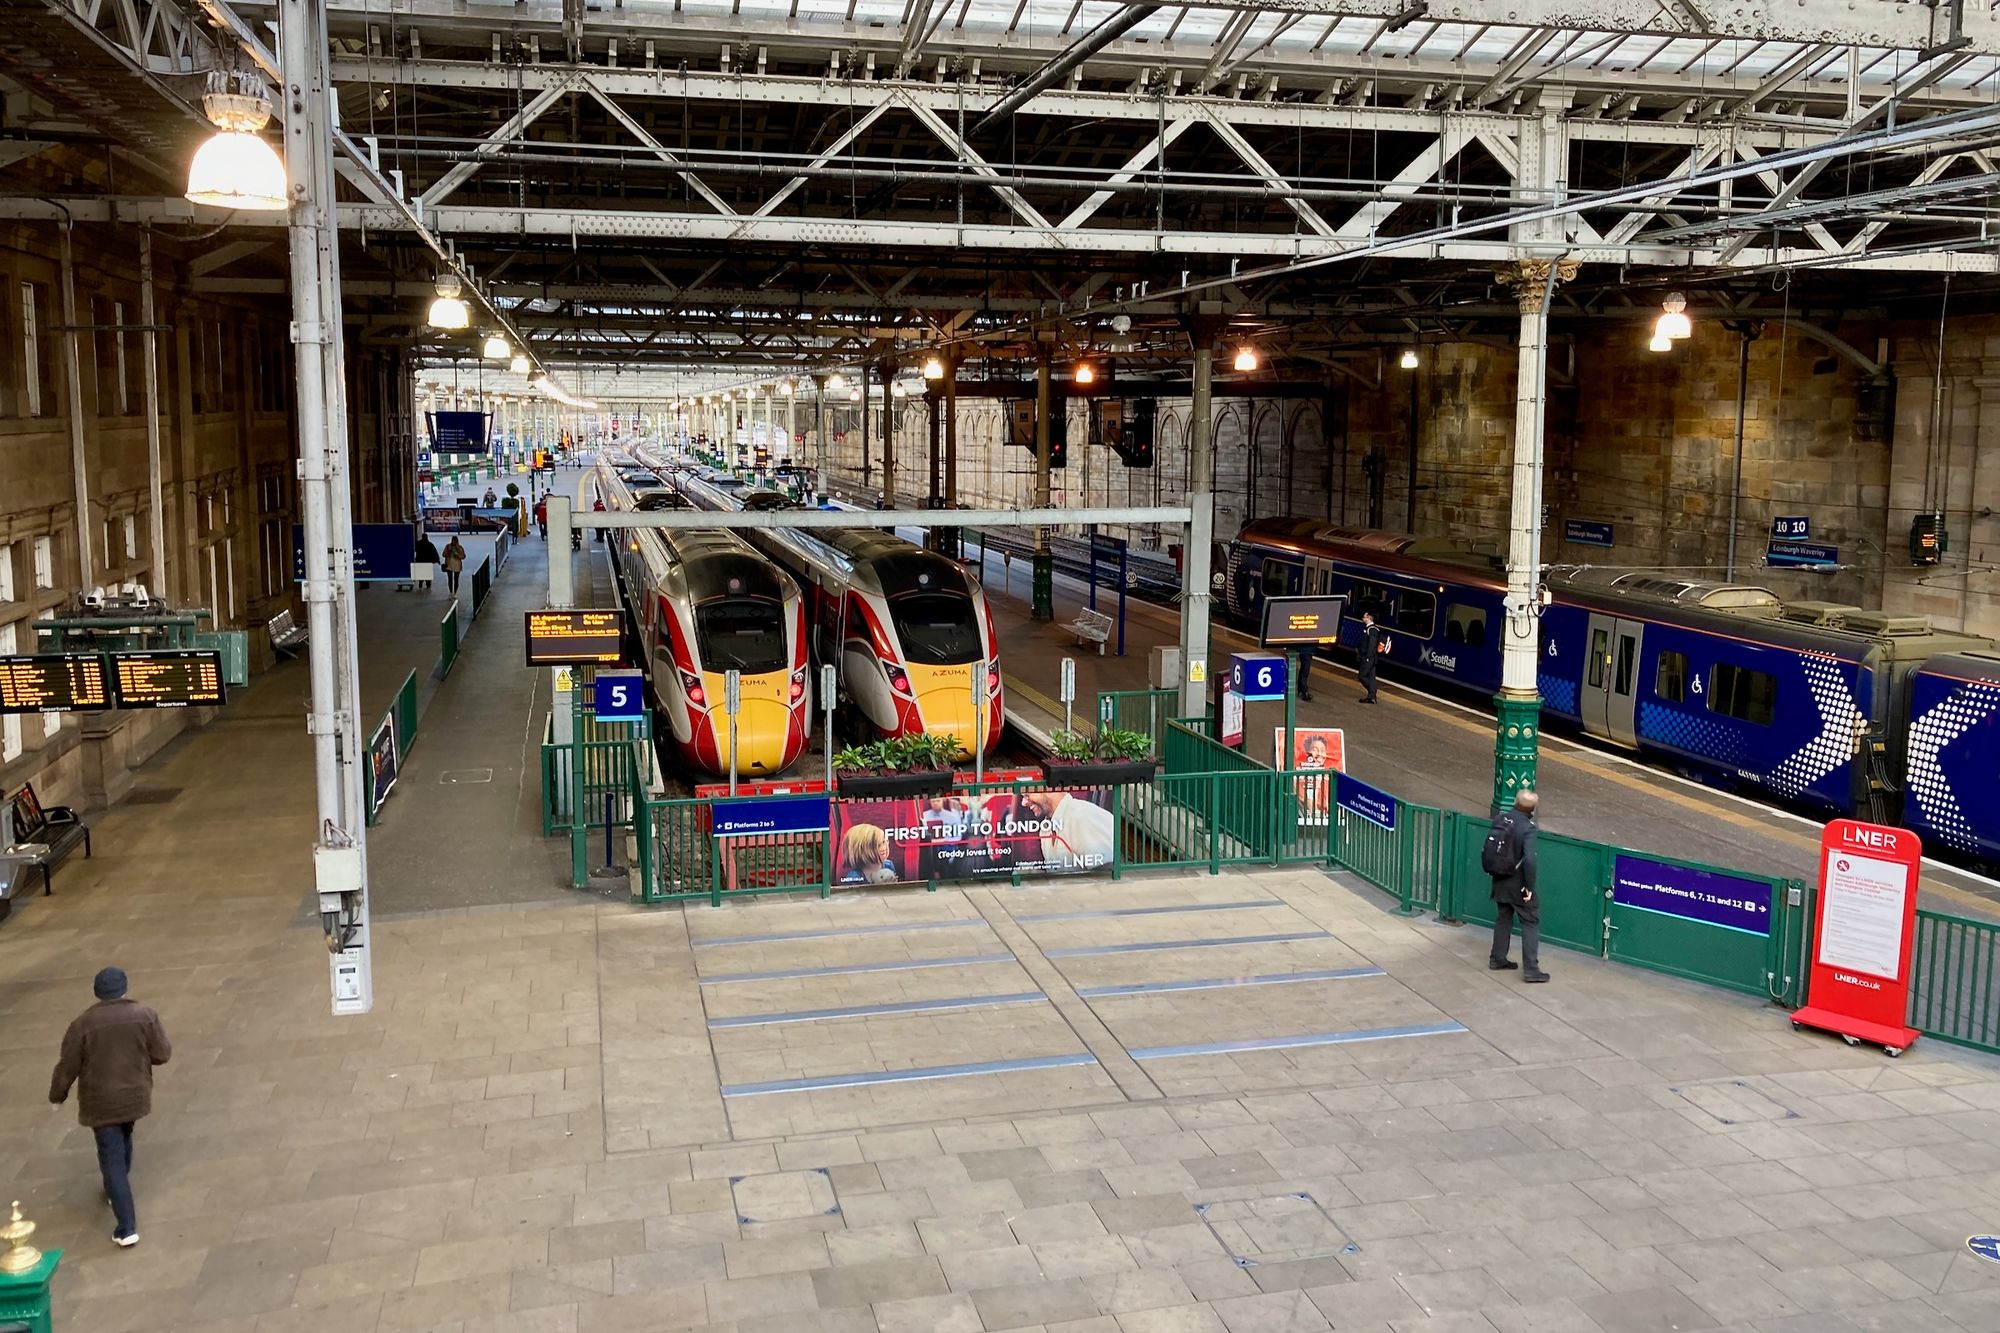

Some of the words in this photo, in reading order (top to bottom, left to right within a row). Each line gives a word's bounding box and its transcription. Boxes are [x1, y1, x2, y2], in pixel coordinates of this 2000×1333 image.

[1776, 520, 1787, 533] 10
[1792, 521, 1805, 534] 10
[1772, 544, 1800, 555] Edinburgh
[1800, 546, 1826, 558] Waverley
[1390, 599, 1394, 617] 1
[1431, 651, 1456, 668] ScotRail
[932, 669, 967, 677] AZUMA
[1234, 664, 1241, 685] 6
[1258, 667, 1272, 688] 6
[612, 685, 627, 707] 5
[885, 826, 929, 841] FIRST
[932, 824, 968, 838] TRIP
[971, 823, 993, 836] TO
[996, 820, 1063, 834] LONDON
[1842, 826, 1896, 850] LNER
[937, 850, 965, 860] (Teddy
[966, 849, 986, 857] loves
[994, 847, 1012, 855] too)
[1064, 853, 1104, 869] LNER
[1654, 884, 1689, 898] Platforms
[1690, 891, 1697, 900] 6,
[1698, 892, 1705, 902] 7,
[1706, 895, 1716, 904] 11
[1717, 898, 1731, 906] and
[1732, 900, 1743, 908] 12
[1834, 972, 1881, 991] LNER.co.uk
